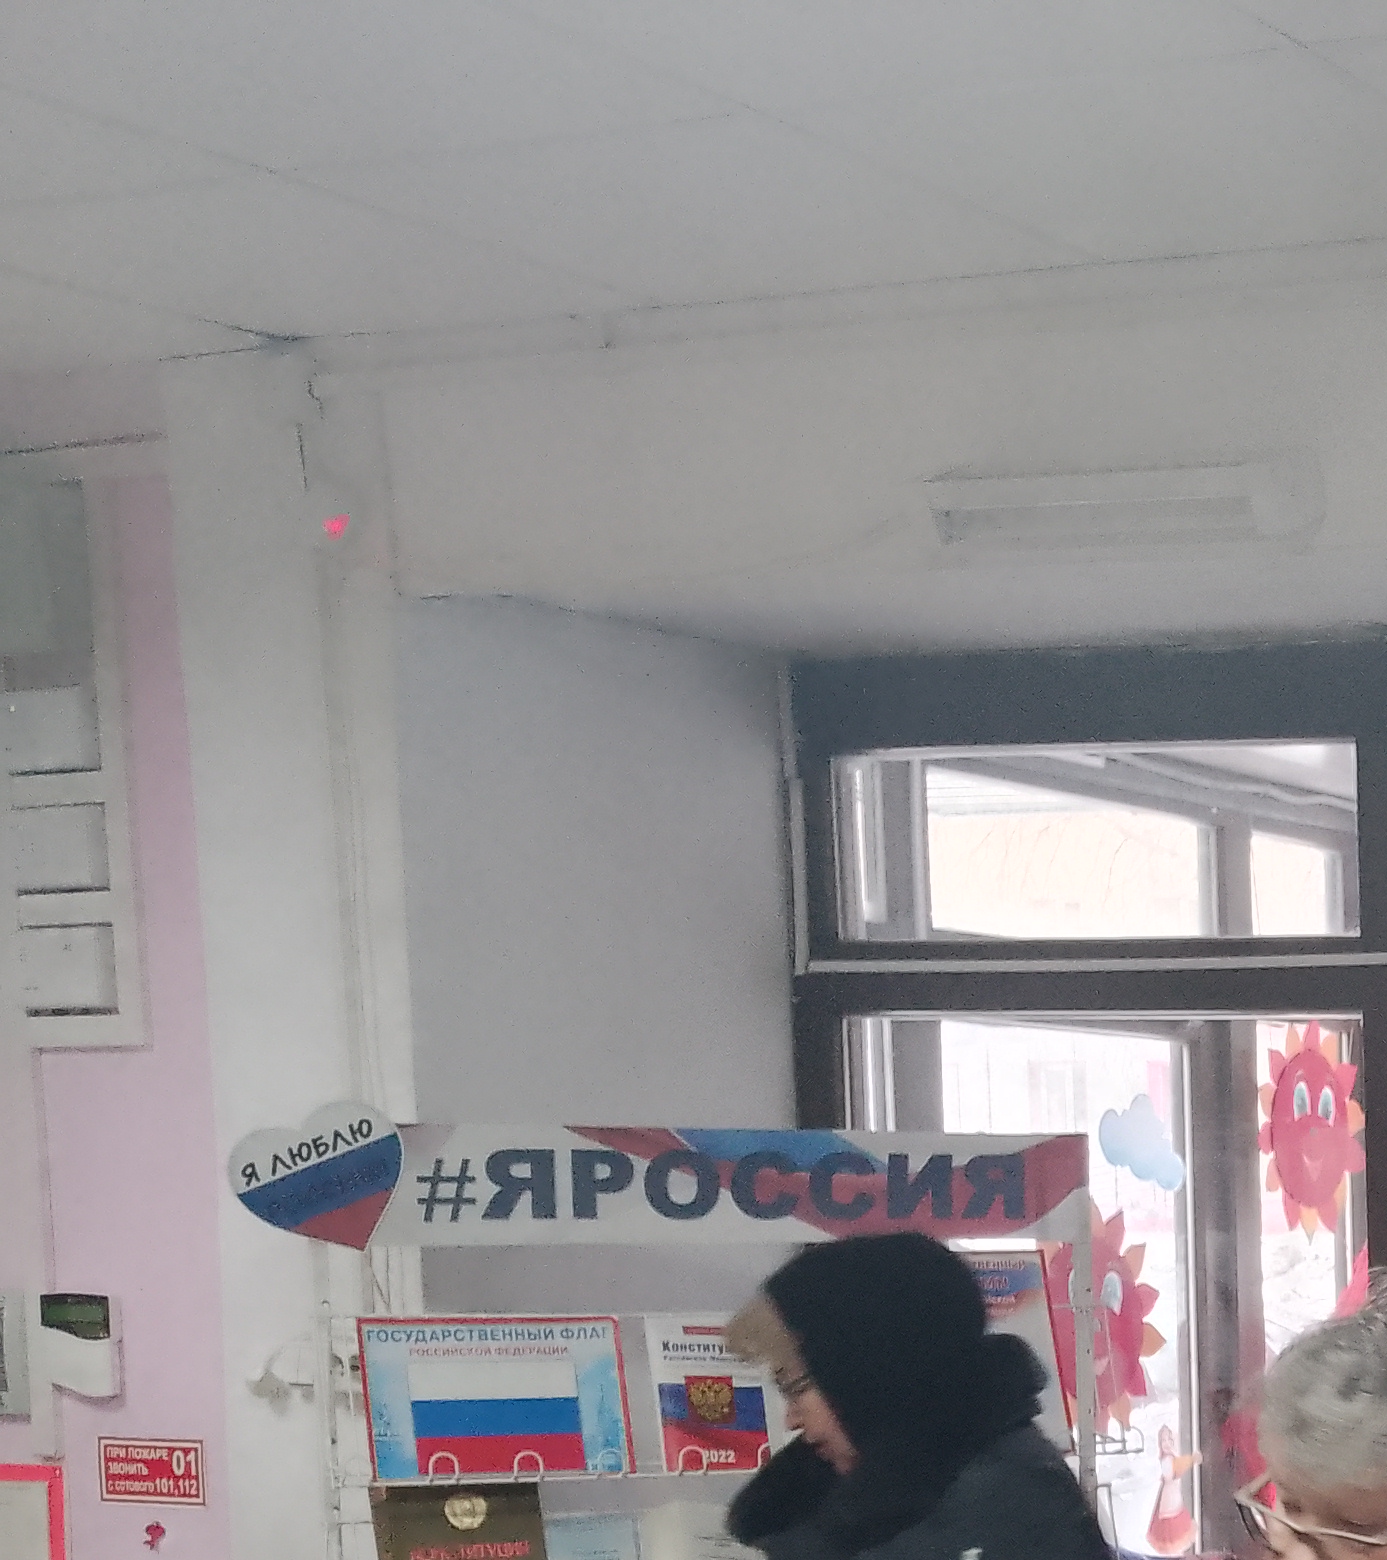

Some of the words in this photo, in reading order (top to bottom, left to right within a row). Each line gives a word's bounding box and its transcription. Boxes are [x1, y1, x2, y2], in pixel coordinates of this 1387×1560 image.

[241, 1162, 261, 1187] Я
[271, 1118, 373, 1176] ЛЮБЛЮ
[415, 1148, 1026, 1222] #ЯРОССИЯ
[366, 1327, 555, 1343] ГОСУДАРСТВЕННЫЙ
[106, 1446, 126, 1459] ПРИ
[128, 1447, 168, 1460] ПОЖАРЕ
[703, 1449, 737, 1463] 2022
[107, 1461, 149, 1475] ЗВОНИТЬ
[171, 1449, 197, 1477] 01
[155, 1477, 198, 1496] 101,112
